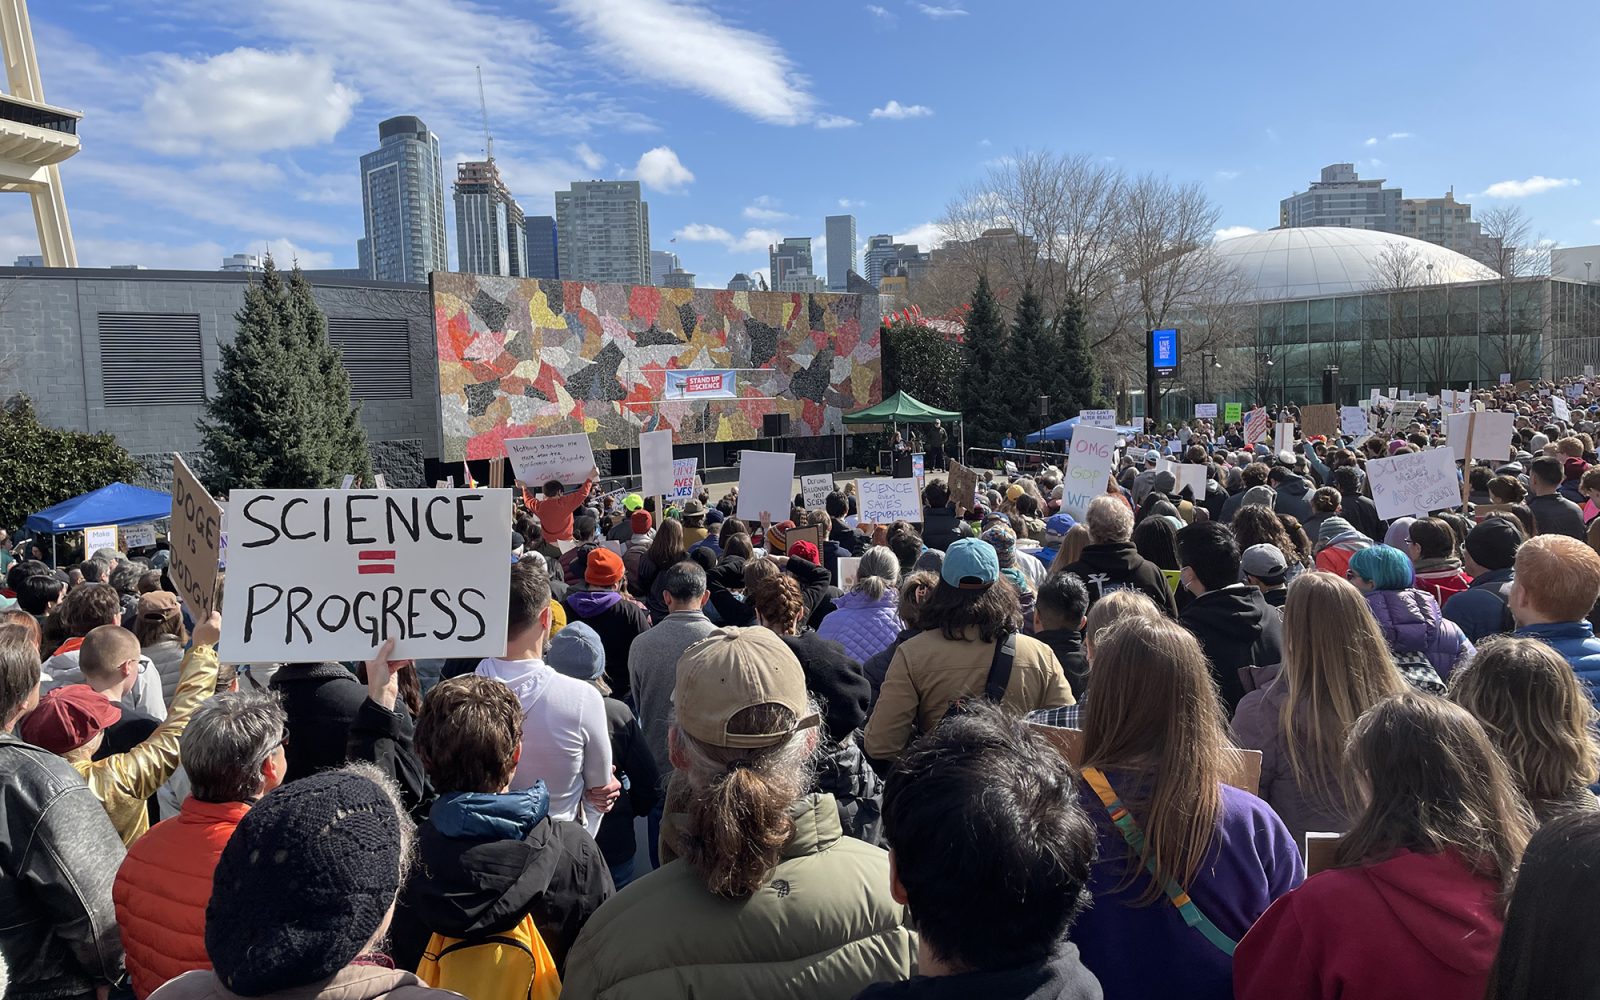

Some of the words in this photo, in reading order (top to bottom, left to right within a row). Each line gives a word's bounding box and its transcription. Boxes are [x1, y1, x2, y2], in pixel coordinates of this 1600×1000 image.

[690, 377, 710, 385] STAND
[695, 383, 720, 391] SCIENCE
[513, 444, 539, 453] Nothing
[1075, 440, 1109, 458] OMG
[673, 478, 694, 487] AVES
[862, 482, 913, 494] SCIENCE
[867, 499, 902, 510] SAVES
[176, 478, 216, 549] DOGE
[242, 494, 485, 548] SCIENCE
[187, 533, 196, 555] IS
[244, 583, 487, 648] PROGRESS
